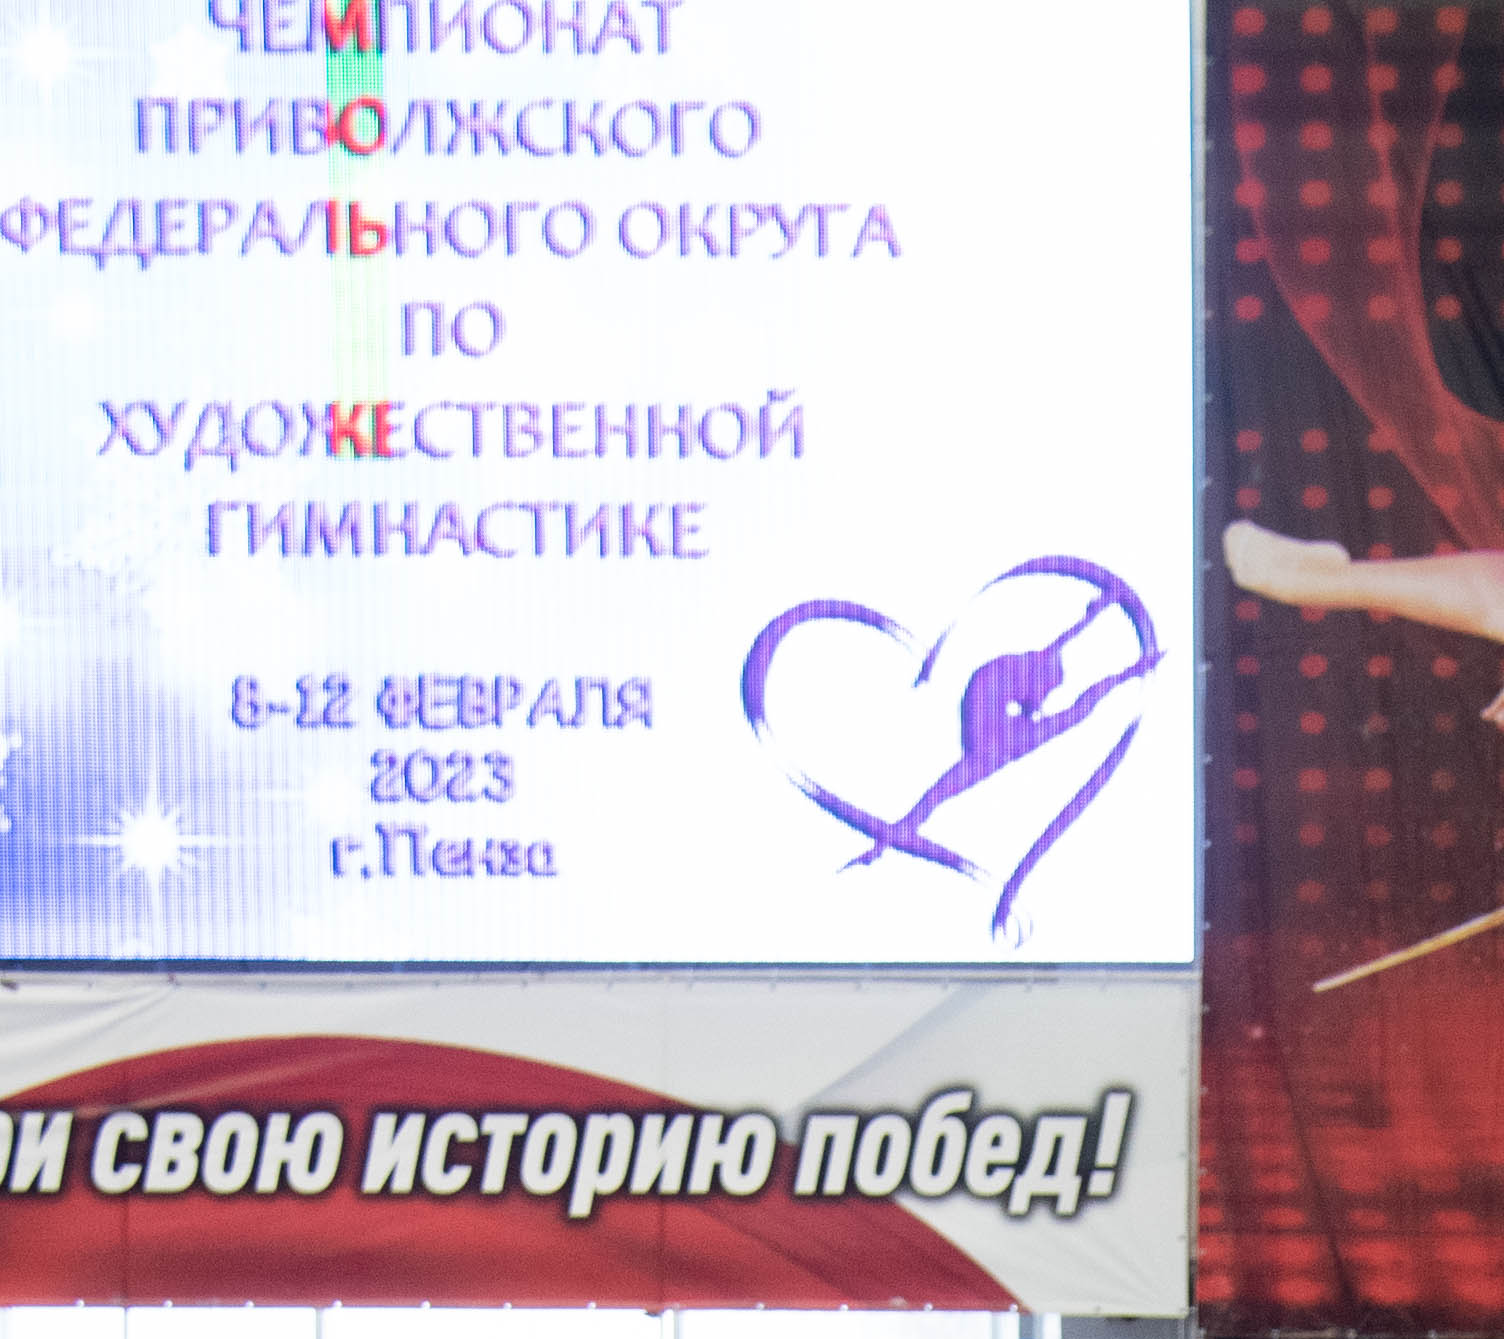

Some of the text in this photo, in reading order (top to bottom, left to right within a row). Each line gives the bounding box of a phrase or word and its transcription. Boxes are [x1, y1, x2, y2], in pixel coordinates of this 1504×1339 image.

[207, 0, 683, 55] ЧЕМПИОНАТ
[135, 95, 760, 158] ПРИВОЛЖСКОГО
[617, 201, 902, 260] ОКРУГА
[401, 301, 505, 359] ПО
[99, 389, 803, 473] ХУДОЖЕСТВЕННОЙ
[205, 500, 706, 560] ГИМНАСТИКЕ
[229, 673, 653, 732] 8-12 ФЕВРАЛЯ
[368, 749, 514, 805] 2023
[329, 821, 557, 881] г.Пенза
[90, 1109, 345, 1195] свою
[360, 1110, 777, 1219] историю
[794, 1089, 1132, 1217] побед!
